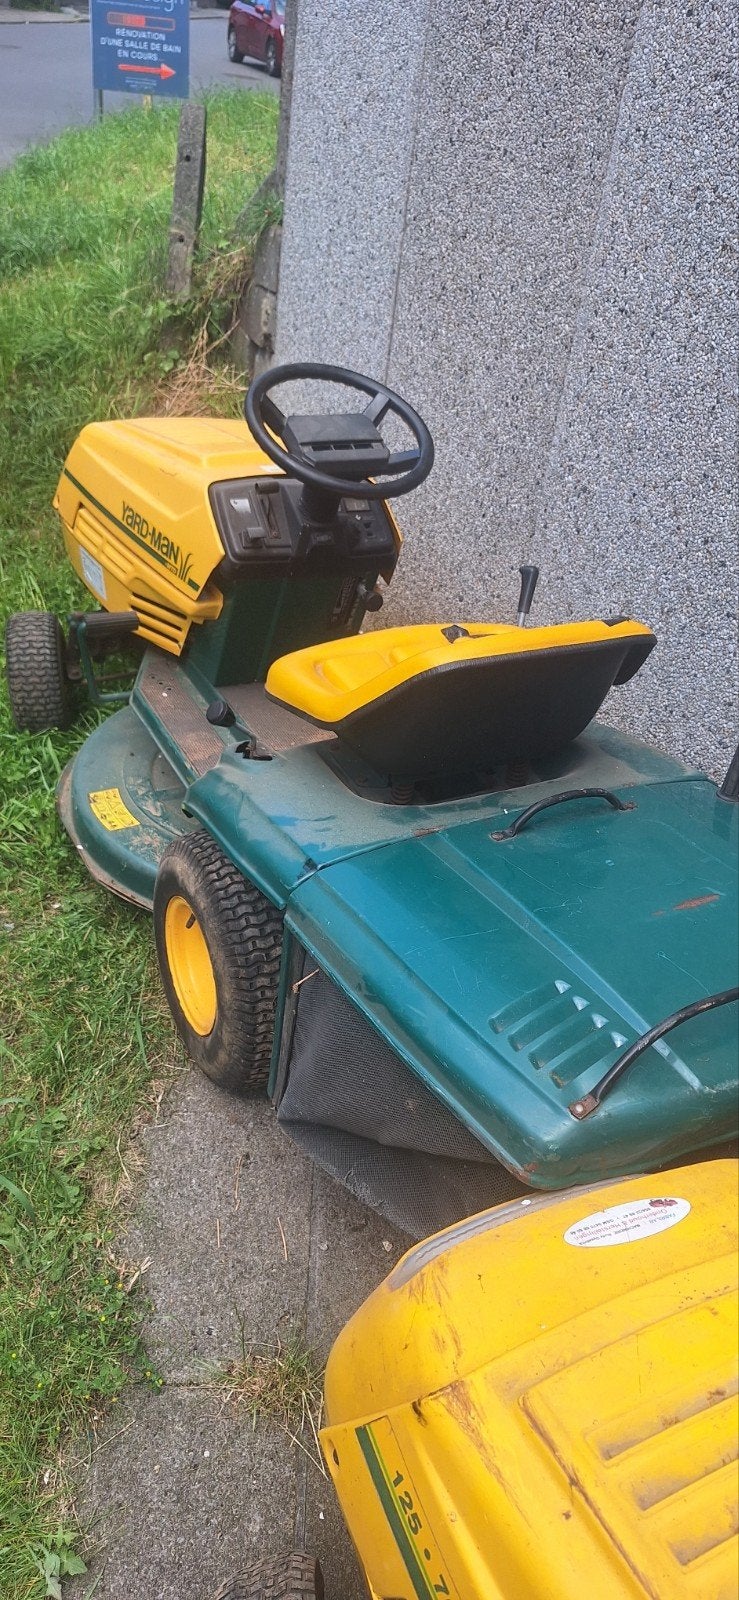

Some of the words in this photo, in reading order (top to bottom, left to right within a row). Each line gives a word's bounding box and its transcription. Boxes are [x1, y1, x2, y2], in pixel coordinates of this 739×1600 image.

[115, 27, 166, 41] RÉNOVATION
[100, 36, 123, 47] D'UNE
[124, 40, 148, 50] SALLE
[150, 43, 161, 52] DE
[162, 43, 182, 53] BAIN
[117, 49, 129, 58] EN
[393, 1470, 423, 1536] 125
